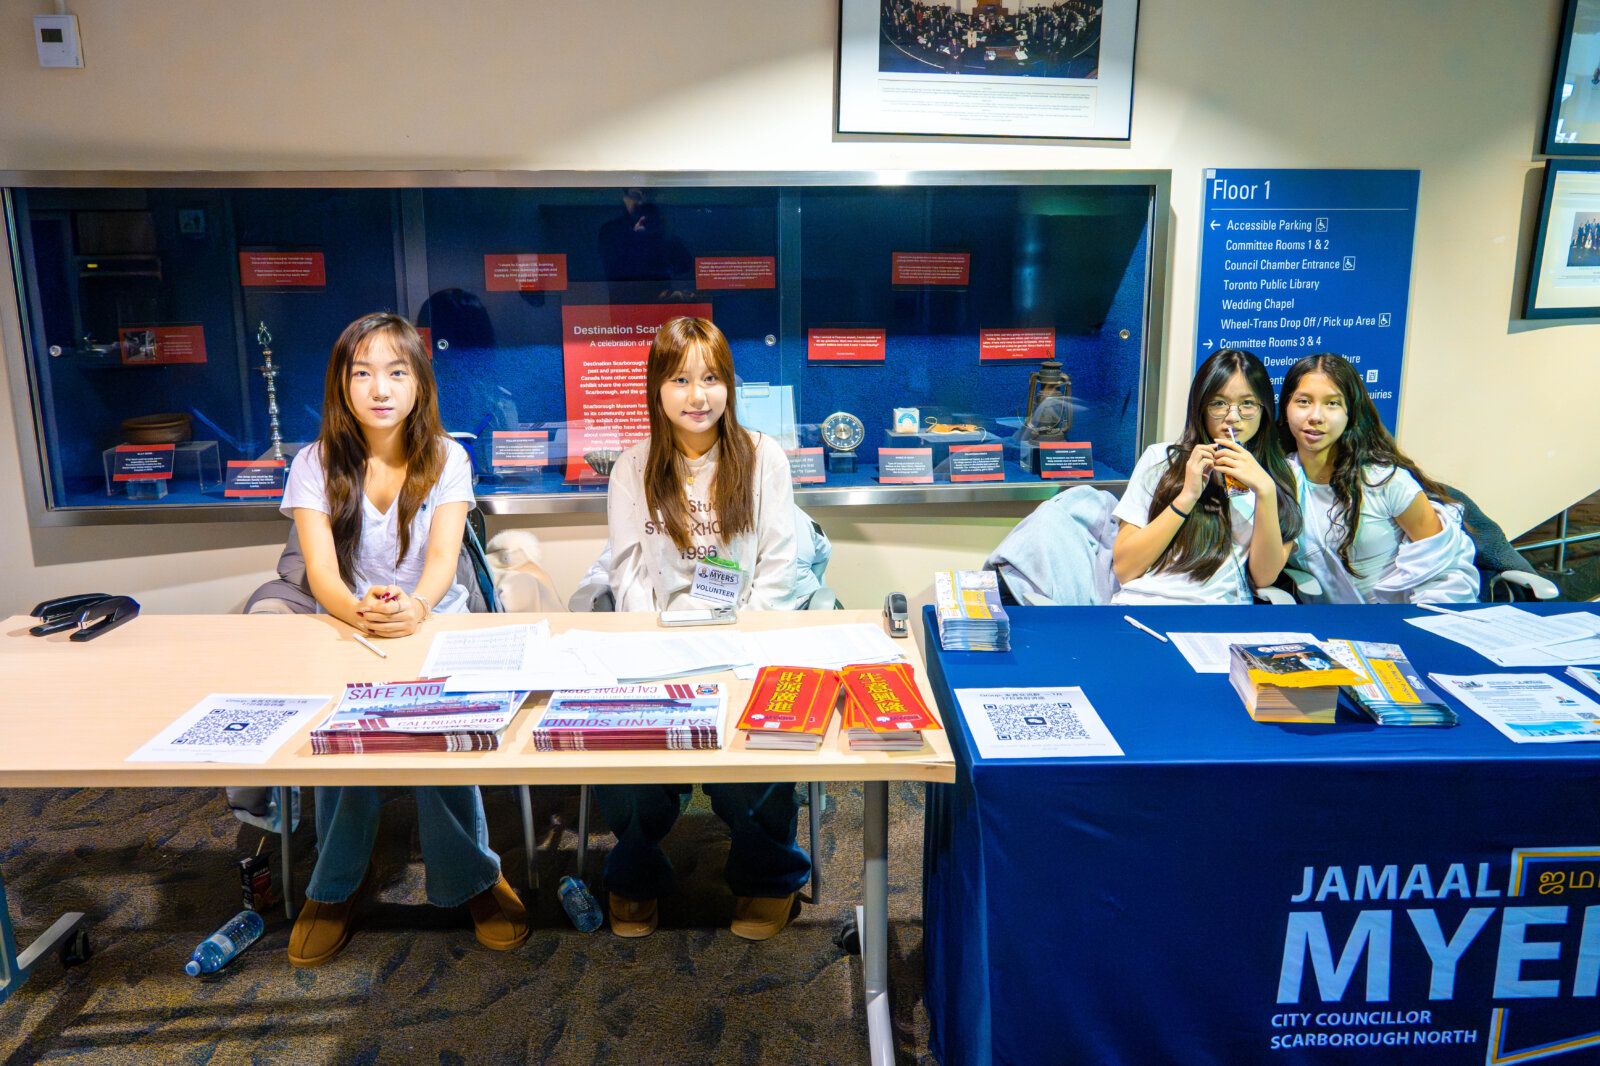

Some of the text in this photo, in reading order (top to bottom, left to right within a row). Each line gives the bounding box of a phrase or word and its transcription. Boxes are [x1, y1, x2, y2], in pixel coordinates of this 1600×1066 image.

[1212, 179, 1270, 200] Floor 1
[1226, 219, 1312, 232] Accessible Parking
[1226, 240, 1329, 251] Committee Rooms 1 & 2
[1224, 259, 1340, 271] Council Chamber Entrance
[1224, 279, 1320, 291] Toronto Public Library
[1222, 298, 1294, 311] Wedding Chapel
[1221, 316, 1376, 330] Wheel-Trans Drop Off / Pick up Area
[574, 325, 633, 335] Destination
[1220, 336, 1322, 349] Committee Rooms 3 & 4
[1368, 390, 1392, 400] uiries
[710, 571, 734, 583] MYERS
[696, 583, 735, 598] VOLUNTEER
[348, 685, 441, 700] SAFE AND
[544, 718, 712, 727] SAFE AND SOUND
[1291, 863, 1501, 902] JAMAAL
[1538, 870, 1600, 895] ஜம
[1271, 1010, 1432, 1027] CITY COUNCILLOR
[1270, 1029, 1478, 1049] SCARBOROUGH NORTH
